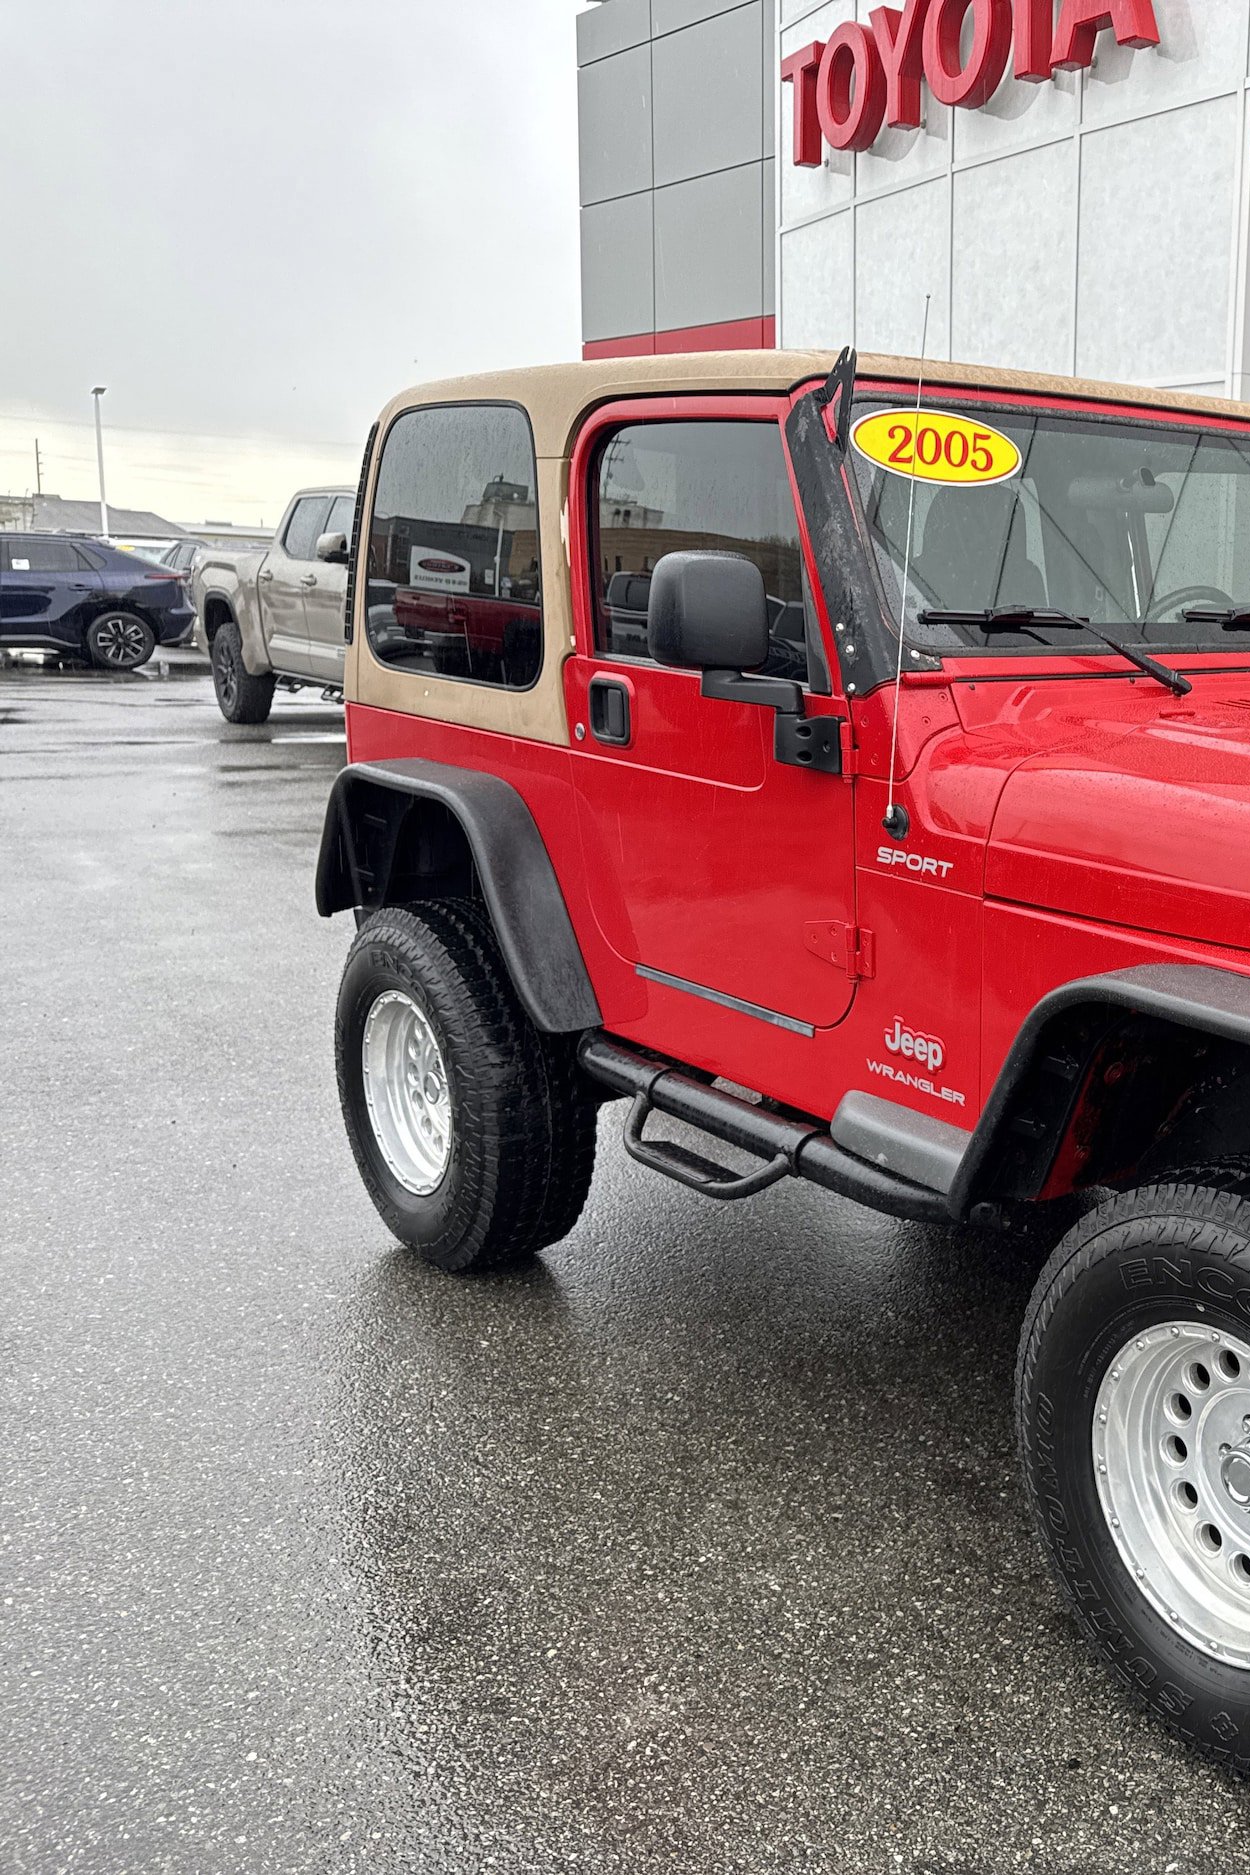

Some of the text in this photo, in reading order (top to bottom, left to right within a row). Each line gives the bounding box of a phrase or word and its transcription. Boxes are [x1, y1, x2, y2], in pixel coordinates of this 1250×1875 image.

[888, 425, 993, 472] 2005
[876, 846, 954, 878] SPORT
[884, 1017, 945, 1073] Jeep
[866, 1057, 966, 1107] WRANGLER
[1035, 1391, 1196, 1716] SUMITOMO
